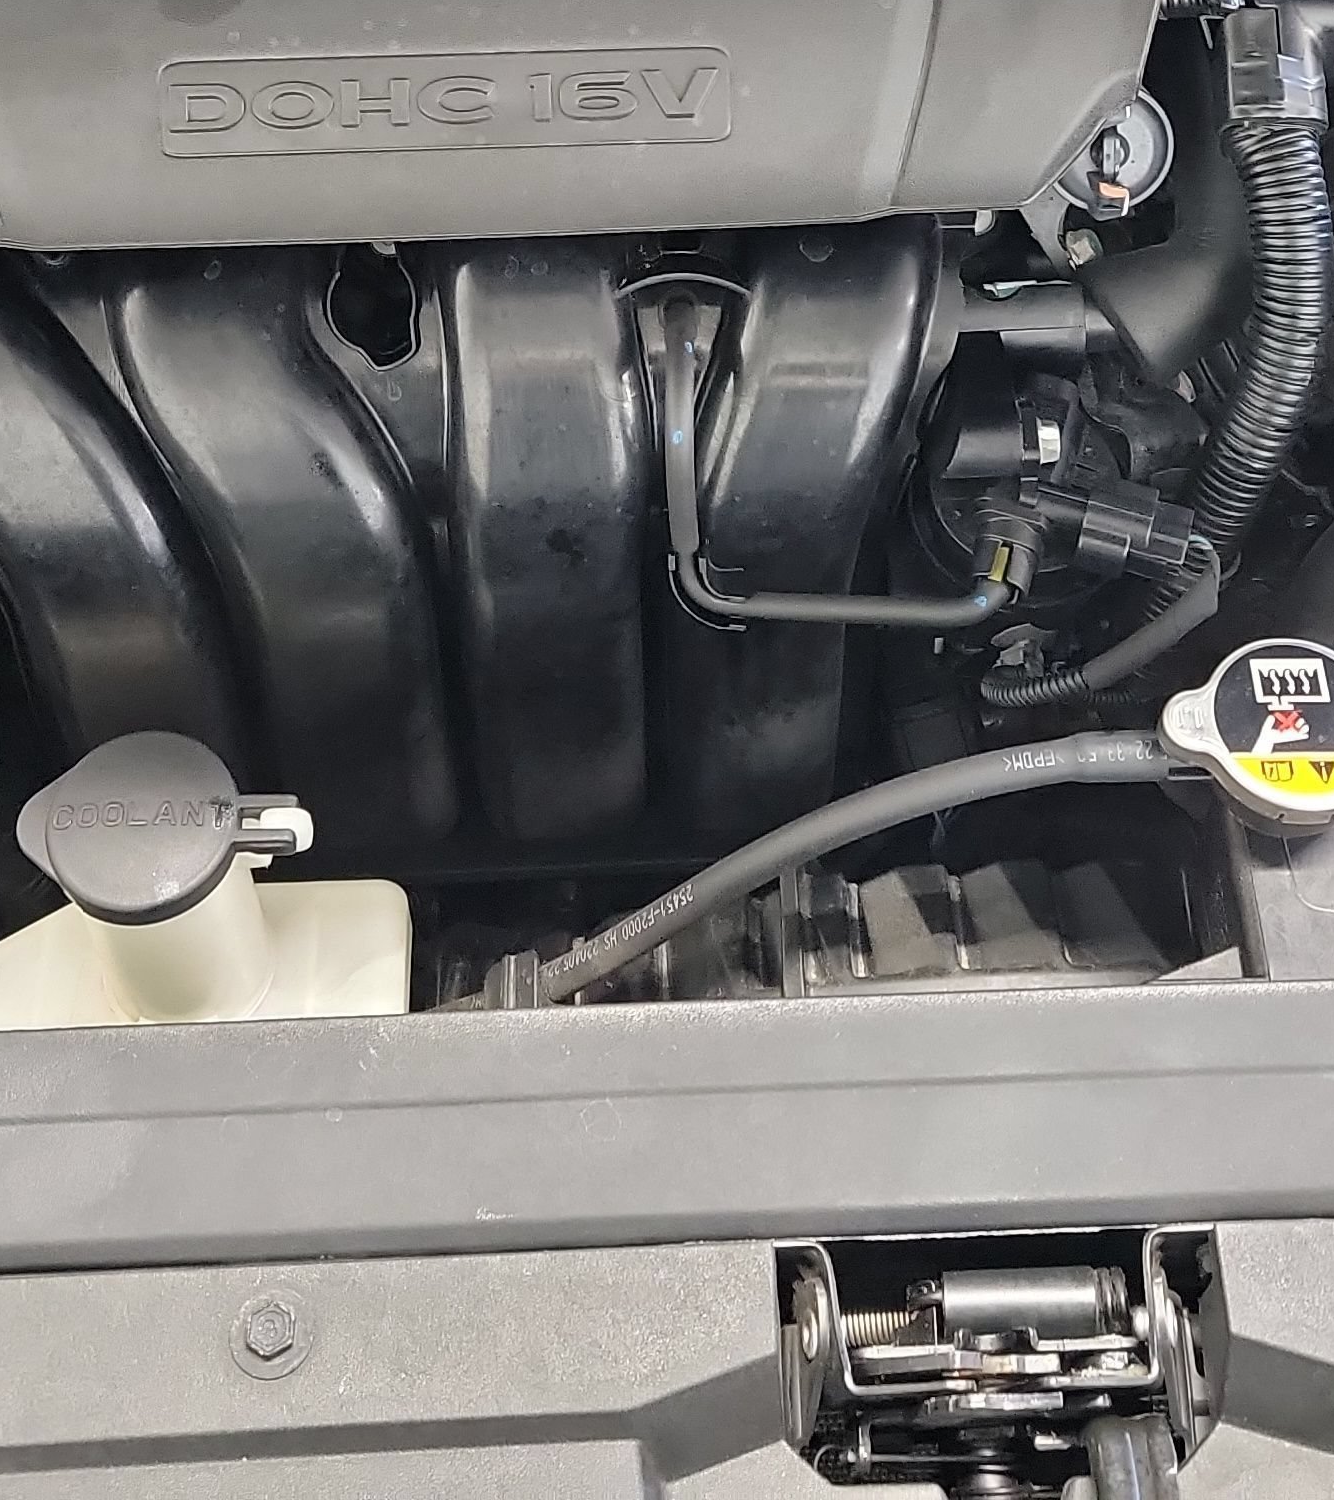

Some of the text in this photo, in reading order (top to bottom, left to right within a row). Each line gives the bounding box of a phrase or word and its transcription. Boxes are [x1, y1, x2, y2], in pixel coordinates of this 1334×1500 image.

[170, 67, 718, 132] DOHC 16V
[51, 801, 232, 830] COOLANT
[621, 884, 694, 941] 25451-F2000
[603, 931, 617, 951] HS
